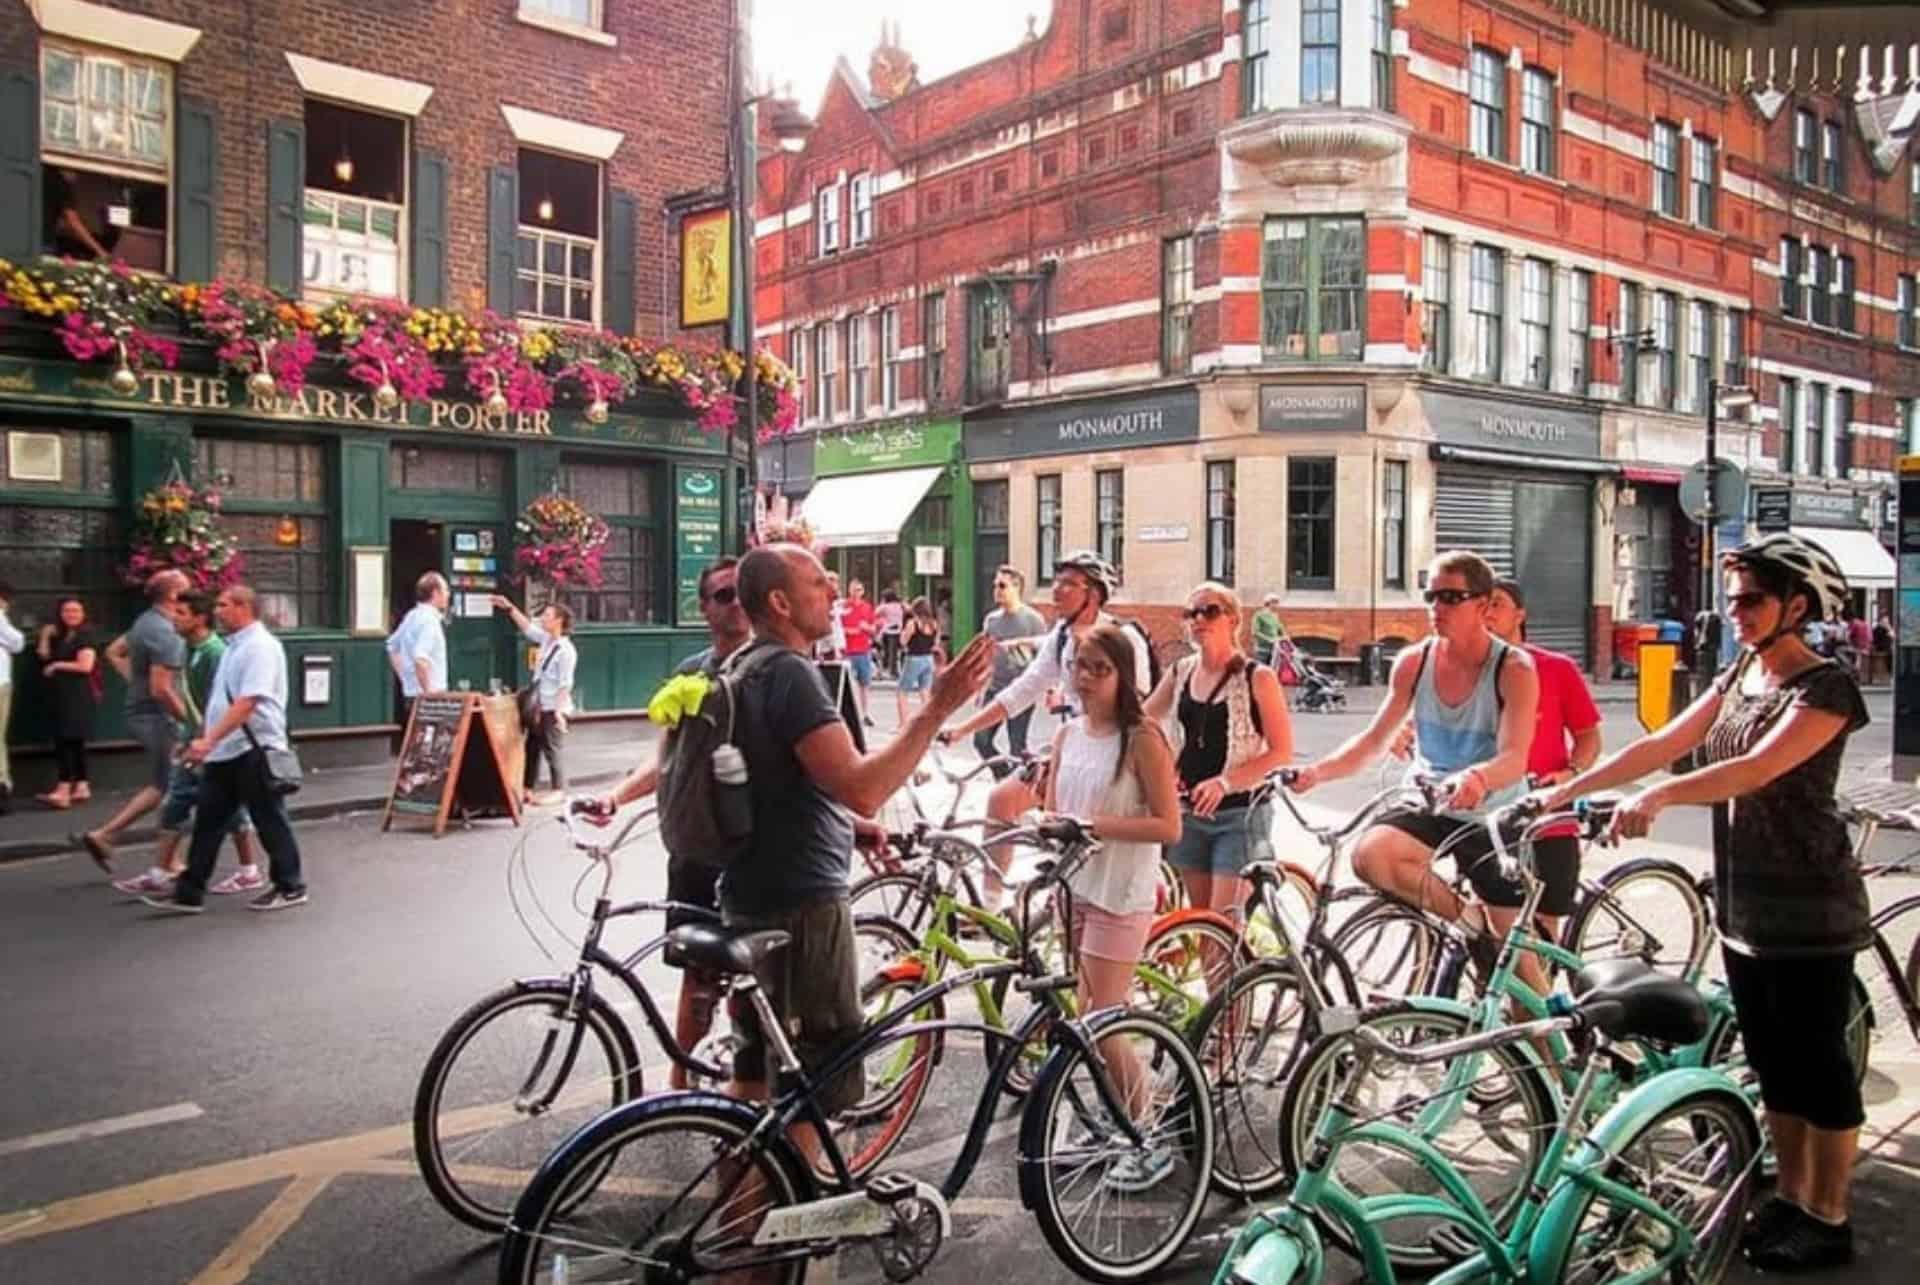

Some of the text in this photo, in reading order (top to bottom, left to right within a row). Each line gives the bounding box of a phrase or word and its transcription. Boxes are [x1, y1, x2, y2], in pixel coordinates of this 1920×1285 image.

[143, 373, 231, 409] THE
[1267, 396, 1358, 409] MONMOUTH
[1058, 410, 1163, 440] MONMOUTH
[1481, 415, 1567, 441] MONMOUTH
